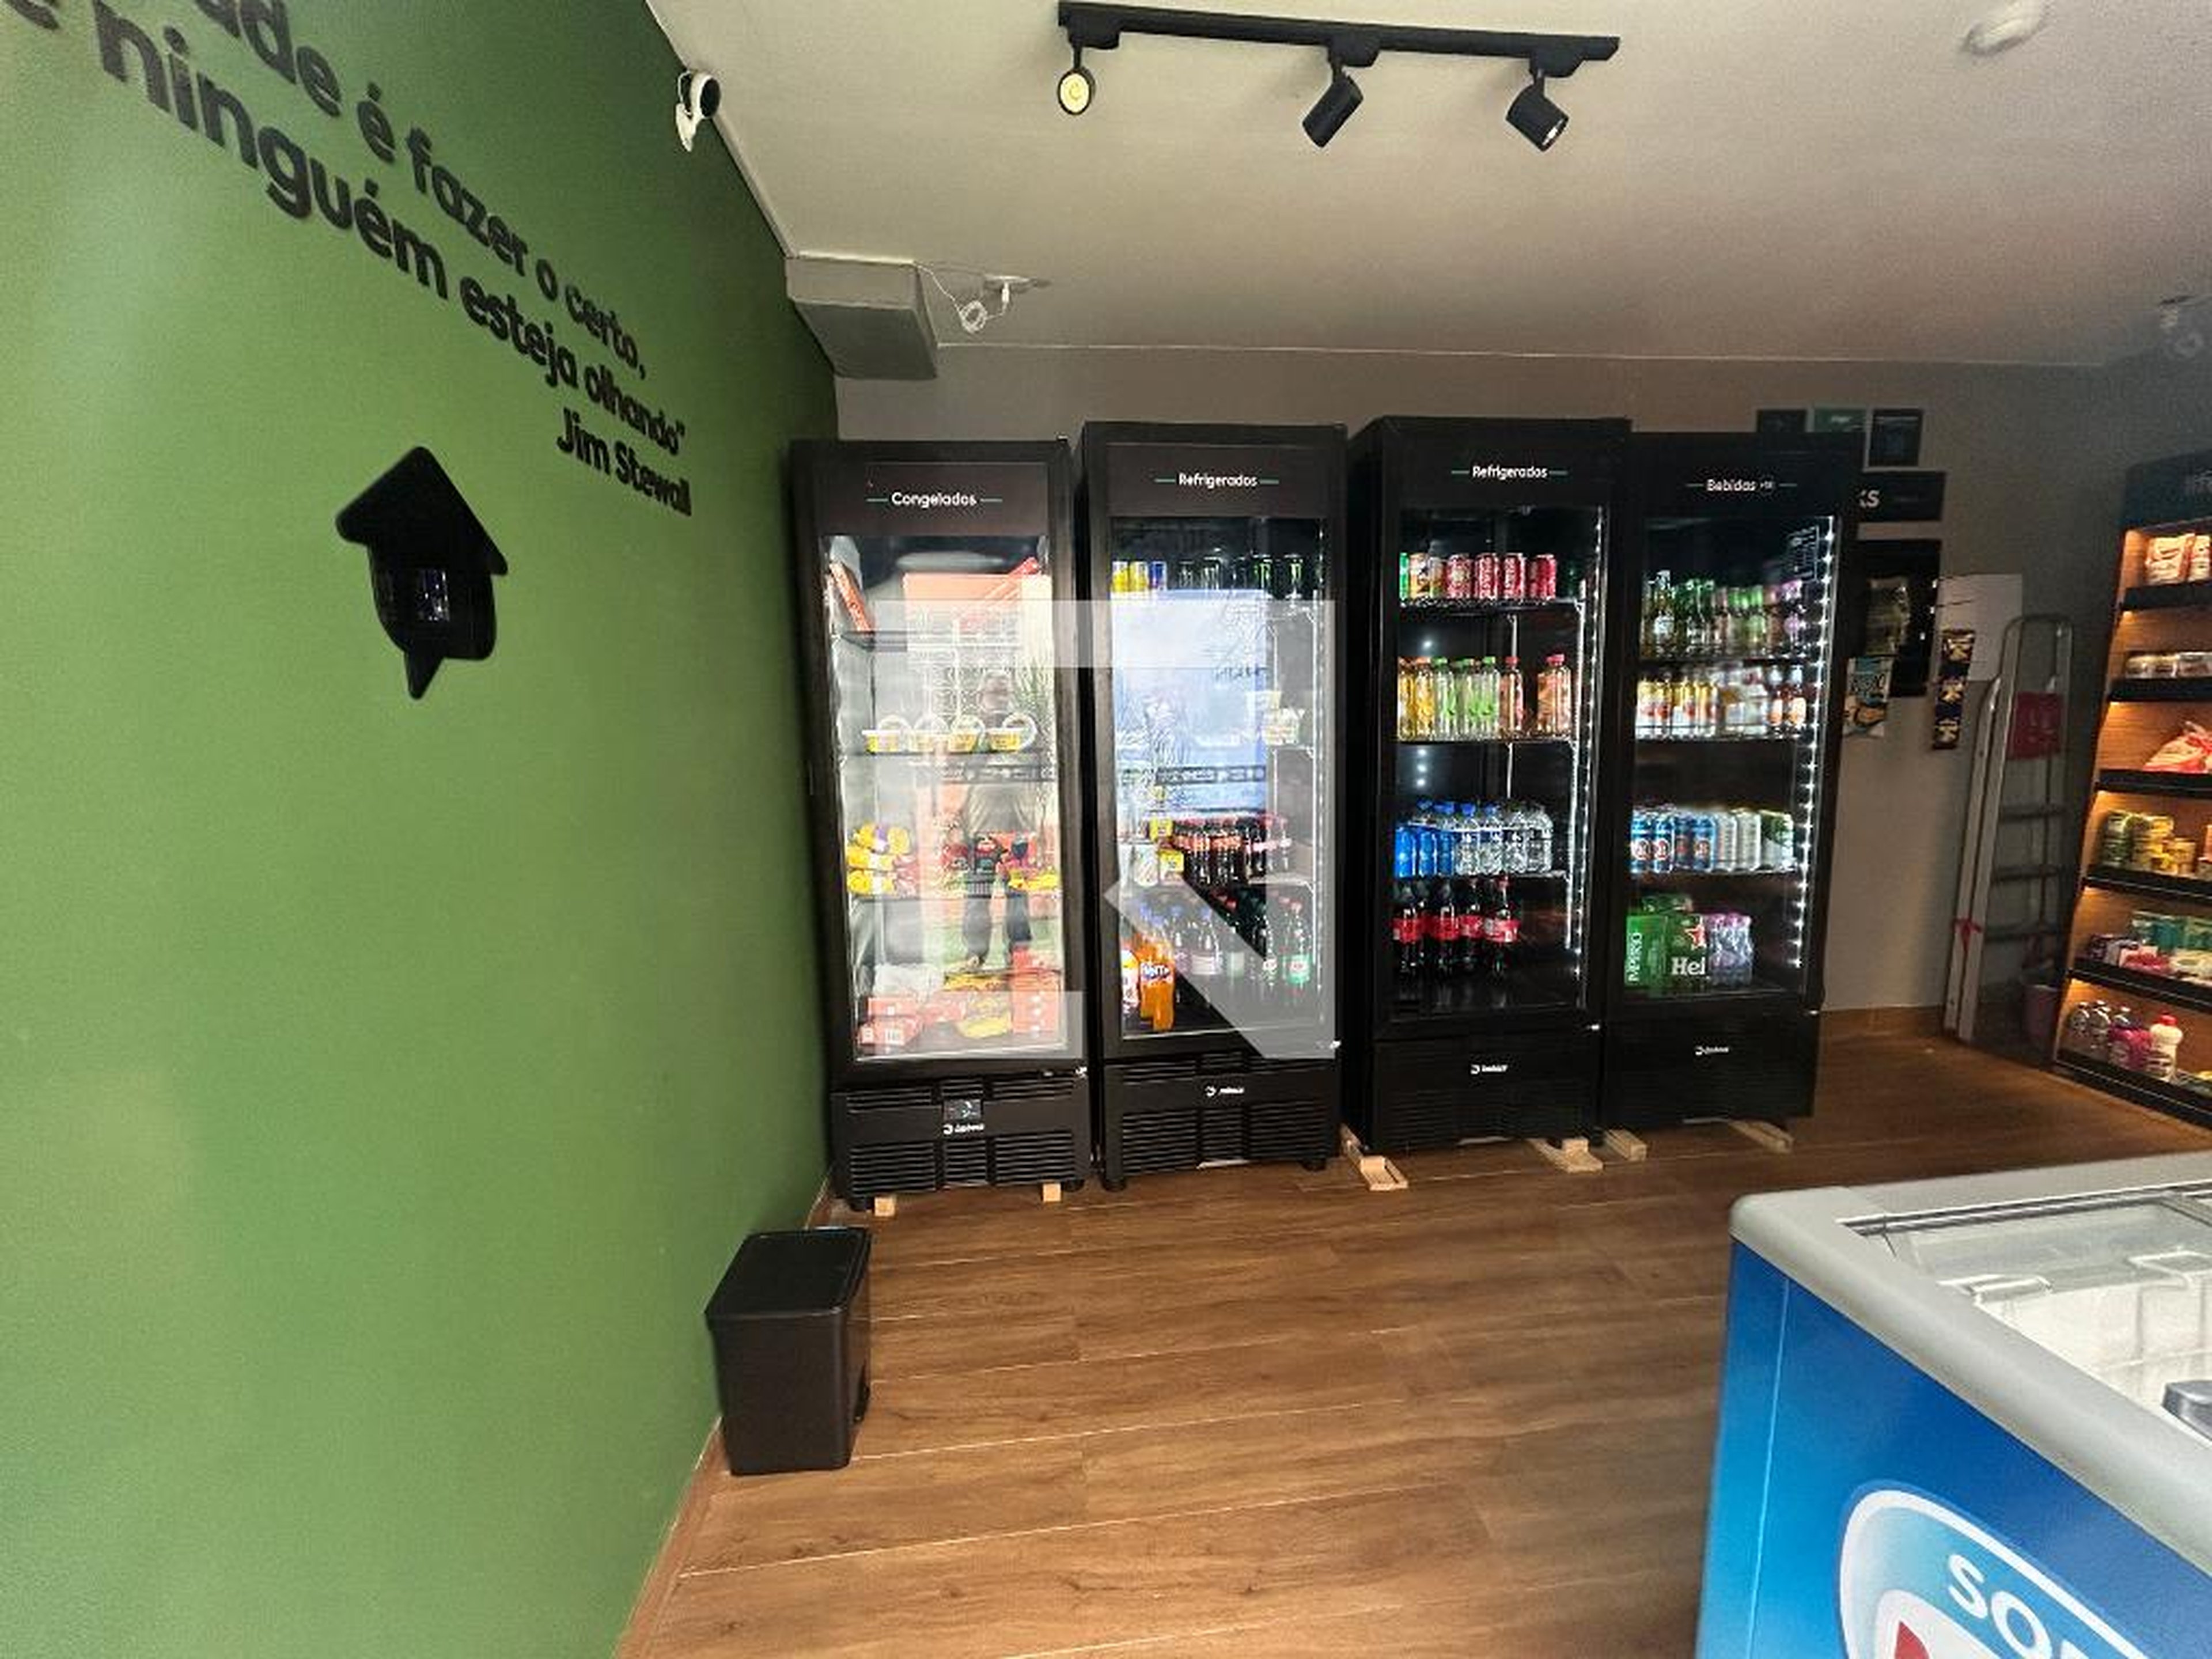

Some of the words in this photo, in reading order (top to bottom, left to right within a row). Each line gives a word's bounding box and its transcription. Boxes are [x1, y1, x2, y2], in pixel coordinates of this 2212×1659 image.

[94, 0, 447, 300] ninguém
[460, 276, 578, 389] esteja
[357, 82, 395, 164] é
[407, 127, 528, 276] fazer
[536, 259, 558, 301] o
[565, 285, 646, 380] certo,
[556, 407, 610, 475] Jim
[1179, 472, 1258, 488] Refrigerados
[1472, 464, 1548, 480] Refrigerados
[1707, 479, 1757, 491] Bebidas
[891, 491, 978, 509] Congelados
[1948, 1554, 2090, 1659] SO
